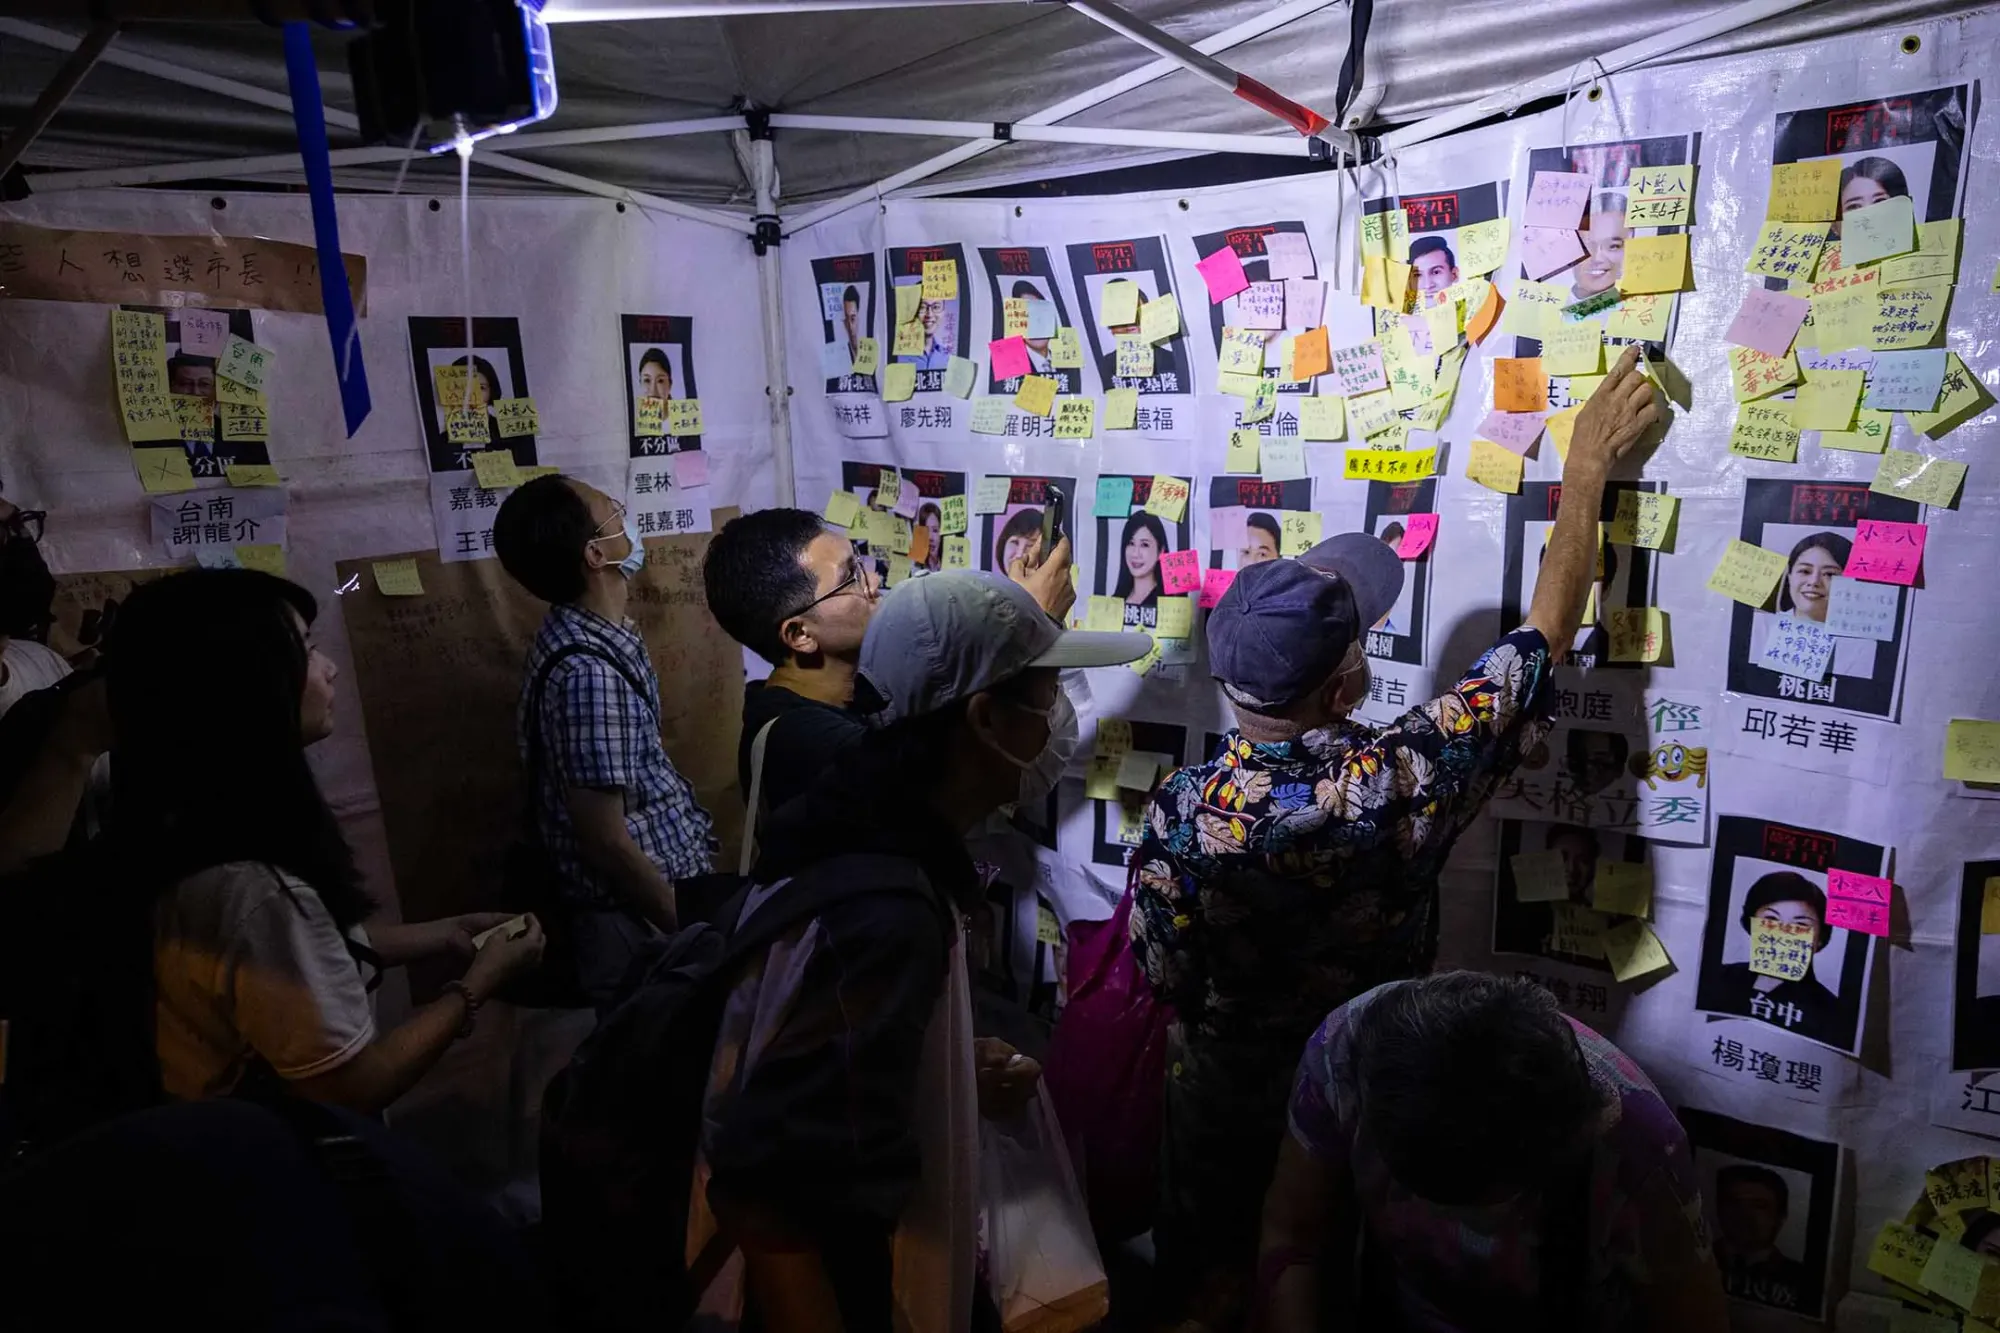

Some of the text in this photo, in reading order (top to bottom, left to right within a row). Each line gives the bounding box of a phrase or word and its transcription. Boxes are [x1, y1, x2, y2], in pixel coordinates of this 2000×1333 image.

[1633, 173, 1686, 195] 小藍八
[1631, 198, 1685, 221] 六點半
[900, 406, 952, 428] 廖先翔
[635, 472, 672, 494] 雲林
[176, 496, 234, 523] 台南
[450, 486, 497, 511] 嘉義
[173, 518, 260, 545] 謝龍介
[638, 508, 694, 534] 張嘉郡
[1124, 604, 1156, 626] 桃園
[1366, 631, 1393, 657] 桃園
[1778, 674, 1837, 703] 桃園
[1742, 708, 1857, 754] 邱若華
[1748, 992, 1804, 1028] 台中
[1711, 1035, 1822, 1093] 楊瓊瓔
[1960, 1082, 2000, 1115] 江
